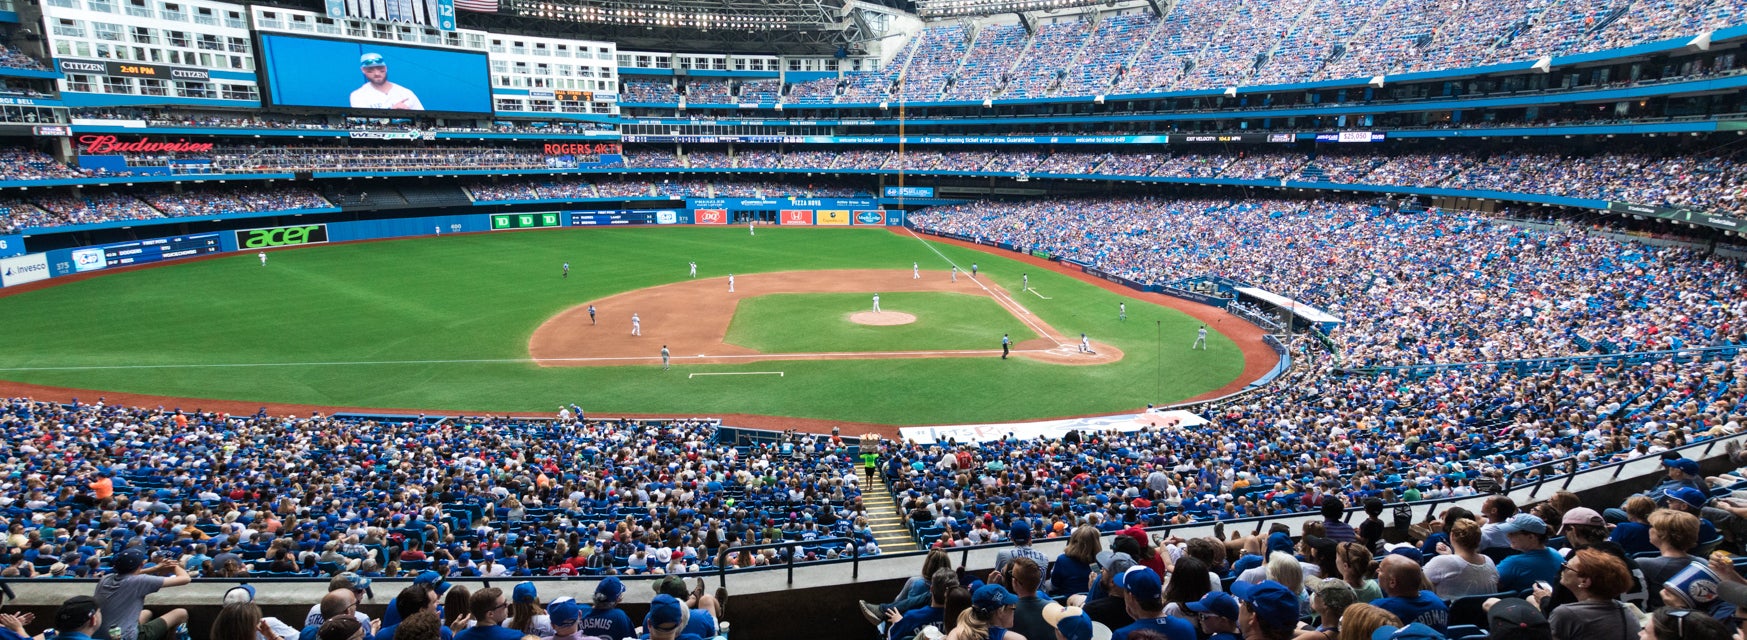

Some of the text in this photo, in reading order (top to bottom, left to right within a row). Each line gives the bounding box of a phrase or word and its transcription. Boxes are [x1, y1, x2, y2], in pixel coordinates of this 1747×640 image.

[439, 4, 453, 17] 12
[61, 61, 105, 72] CITIZEN
[120, 65, 155, 75] 2:01 PM
[172, 69, 208, 79] CITIZEN
[1343, 132, 1367, 141] $25,050
[79, 134, 214, 153] Budweiser
[543, 143, 591, 155] ROGERS
[496, 217, 509, 226] TD
[519, 216, 533, 225] TD
[543, 215, 556, 224] TD
[704, 213, 717, 221] DQ
[245, 225, 319, 248] acer
[17, 262, 46, 273] invesco
[578, 618, 613, 631] RASMUS
